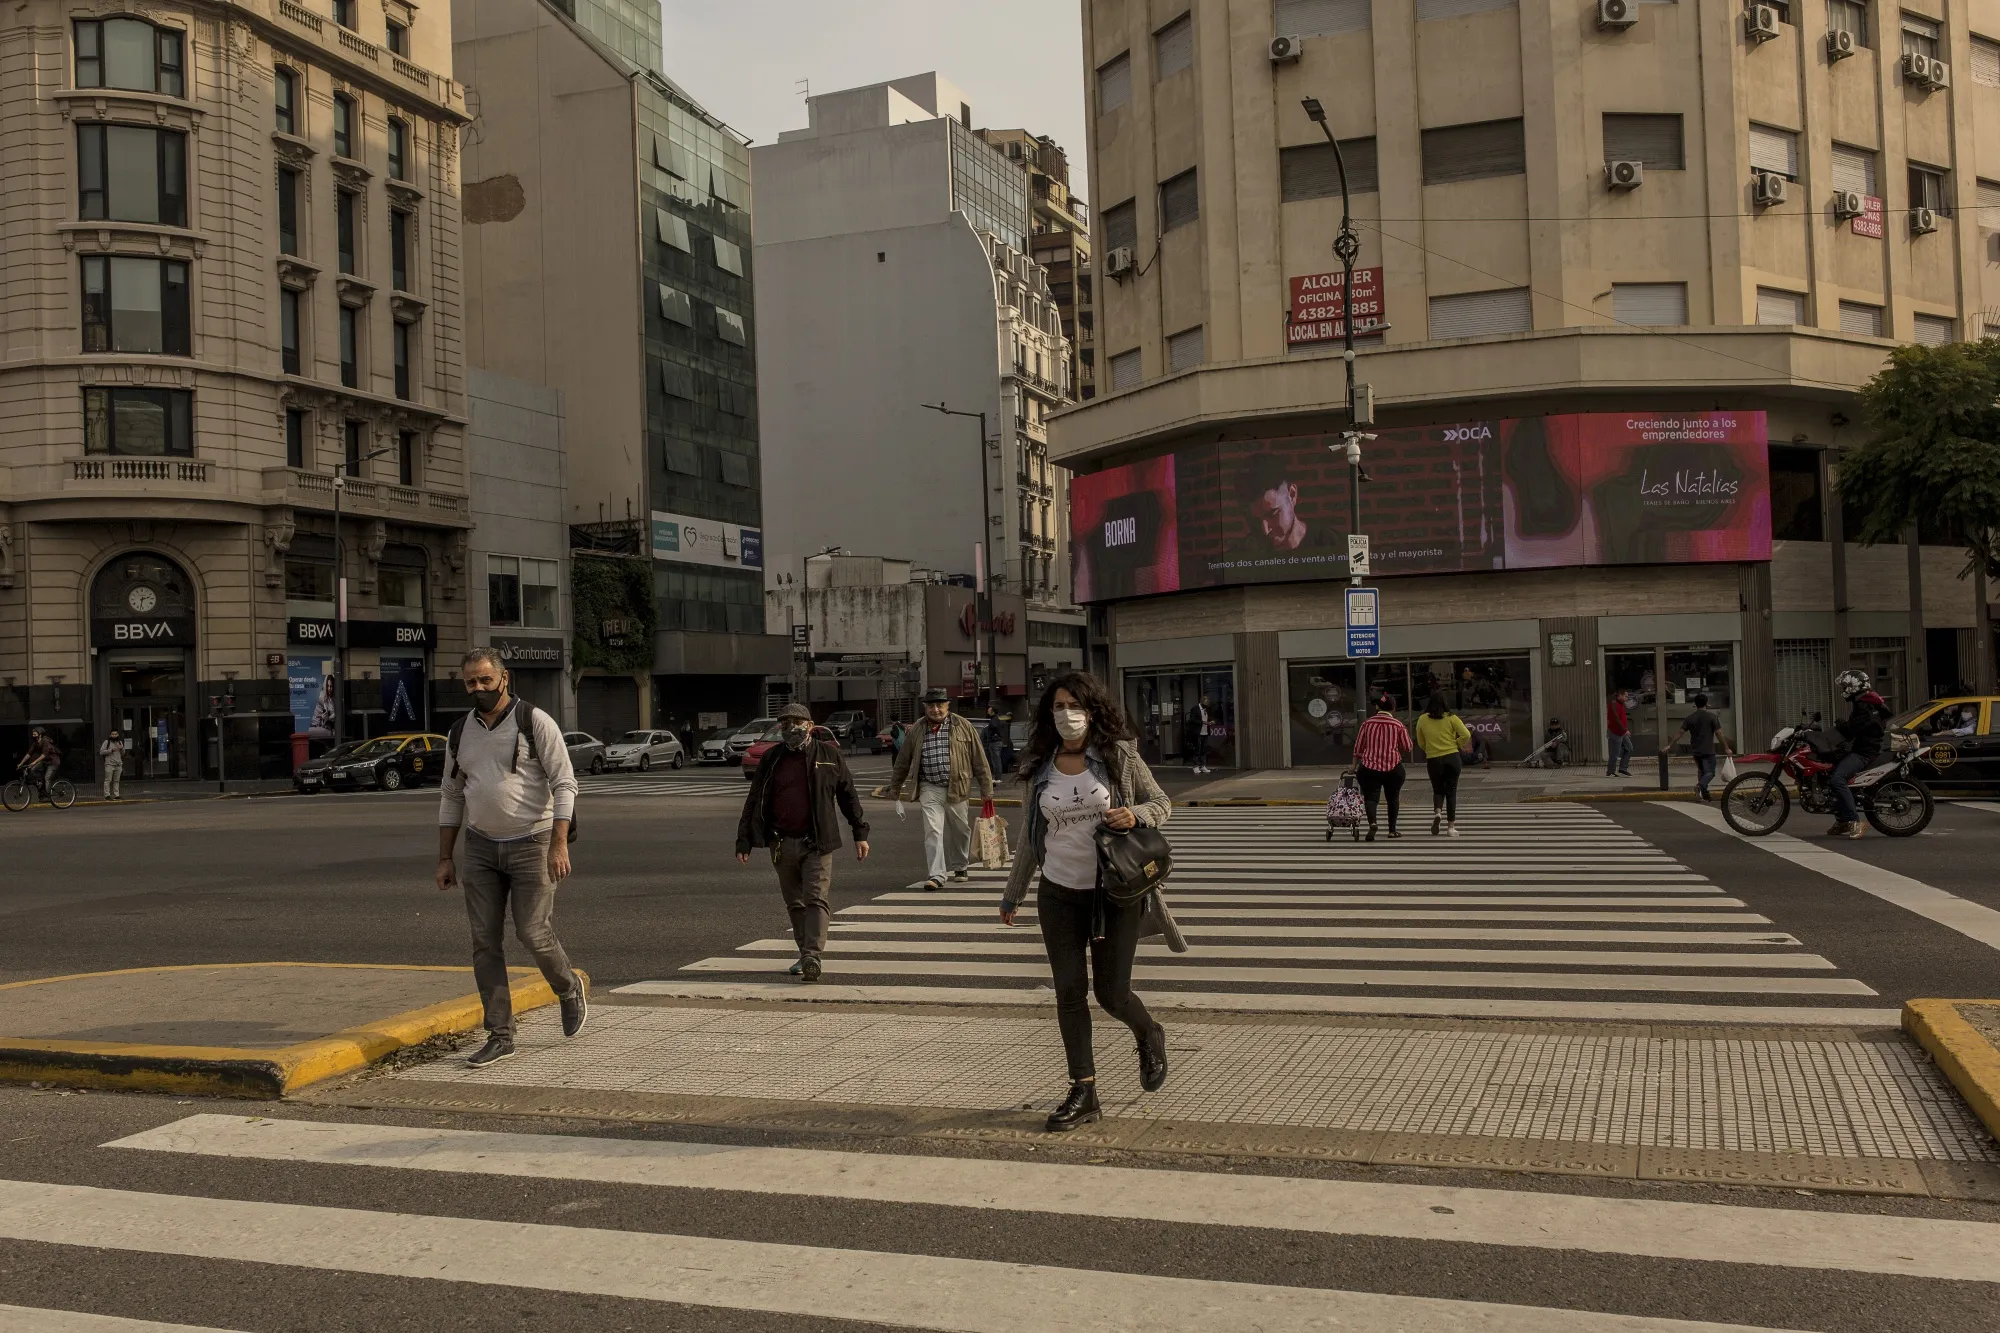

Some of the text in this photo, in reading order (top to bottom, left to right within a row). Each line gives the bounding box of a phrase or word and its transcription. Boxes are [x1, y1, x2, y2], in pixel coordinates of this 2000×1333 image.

[1301, 270, 1372, 290] ALQUIER
[1298, 290, 1342, 305] OFICINA
[1289, 322, 1319, 341] LOCAL
[1320, 321, 1333, 338] EN
[1626, 417, 1737, 430] Creciendo junto a los
[1459, 427, 1492, 440] OCA
[1642, 428, 1725, 442] emprendedores
[1640, 468, 1738, 496] Las Natalias
[1695, 498, 1719, 506] BUENOS
[1104, 516, 1136, 548] BORNA
[1236, 558, 1252, 568] dos
[1254, 556, 1287, 567] canales
[1288, 555, 1300, 565] de
[1301, 555, 1327, 565] venta
[1327, 553, 1336, 563] el
[1380, 551, 1387, 562] y
[1388, 549, 1397, 559] el
[1398, 547, 1443, 559] mayorista
[114, 621, 174, 640] BBVA
[299, 623, 334, 640] BBVA
[396, 626, 427, 642] BBVA
[512, 646, 561, 661] Santander
[288, 676, 303, 684] Operar
[1477, 723, 1502, 733] OCA
[1390, 1151, 1620, 1173] PRECAUCION
[1657, 1167, 1907, 1190] PRECAUCION
